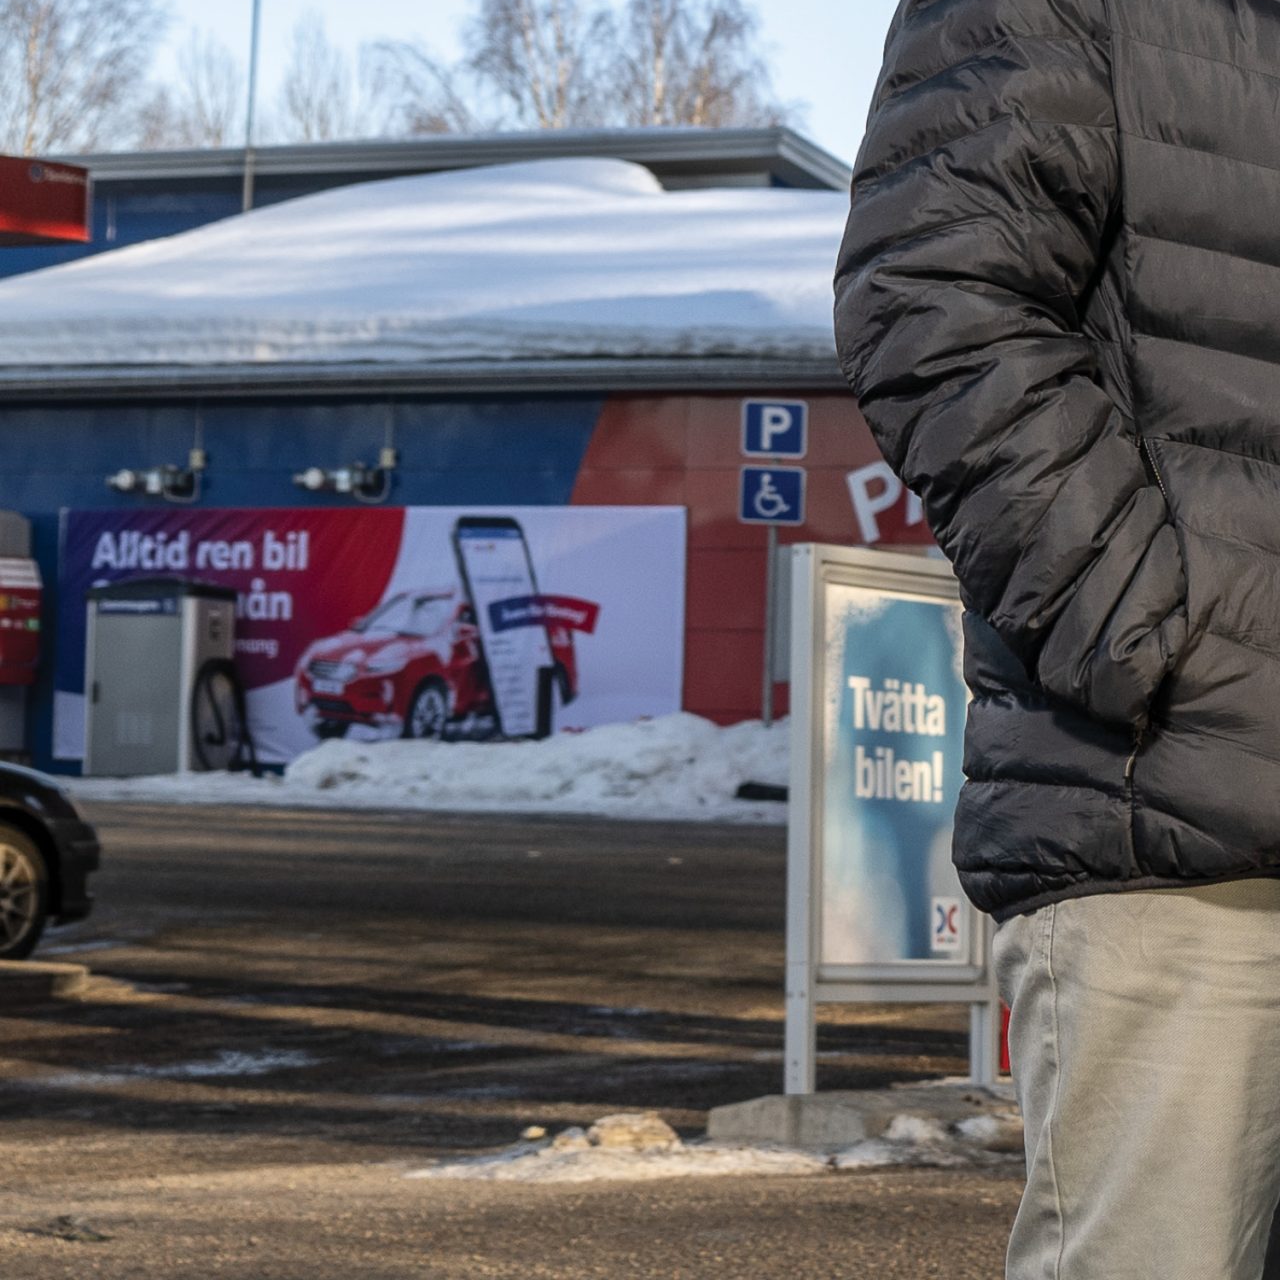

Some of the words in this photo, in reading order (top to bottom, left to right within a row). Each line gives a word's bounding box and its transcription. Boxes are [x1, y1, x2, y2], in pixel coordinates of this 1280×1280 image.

[761, 406, 793, 451] P
[195, 540, 254, 570] ren
[262, 530, 310, 571] bil
[848, 675, 946, 737] Tvätta
[855, 745, 943, 803] bilen!
